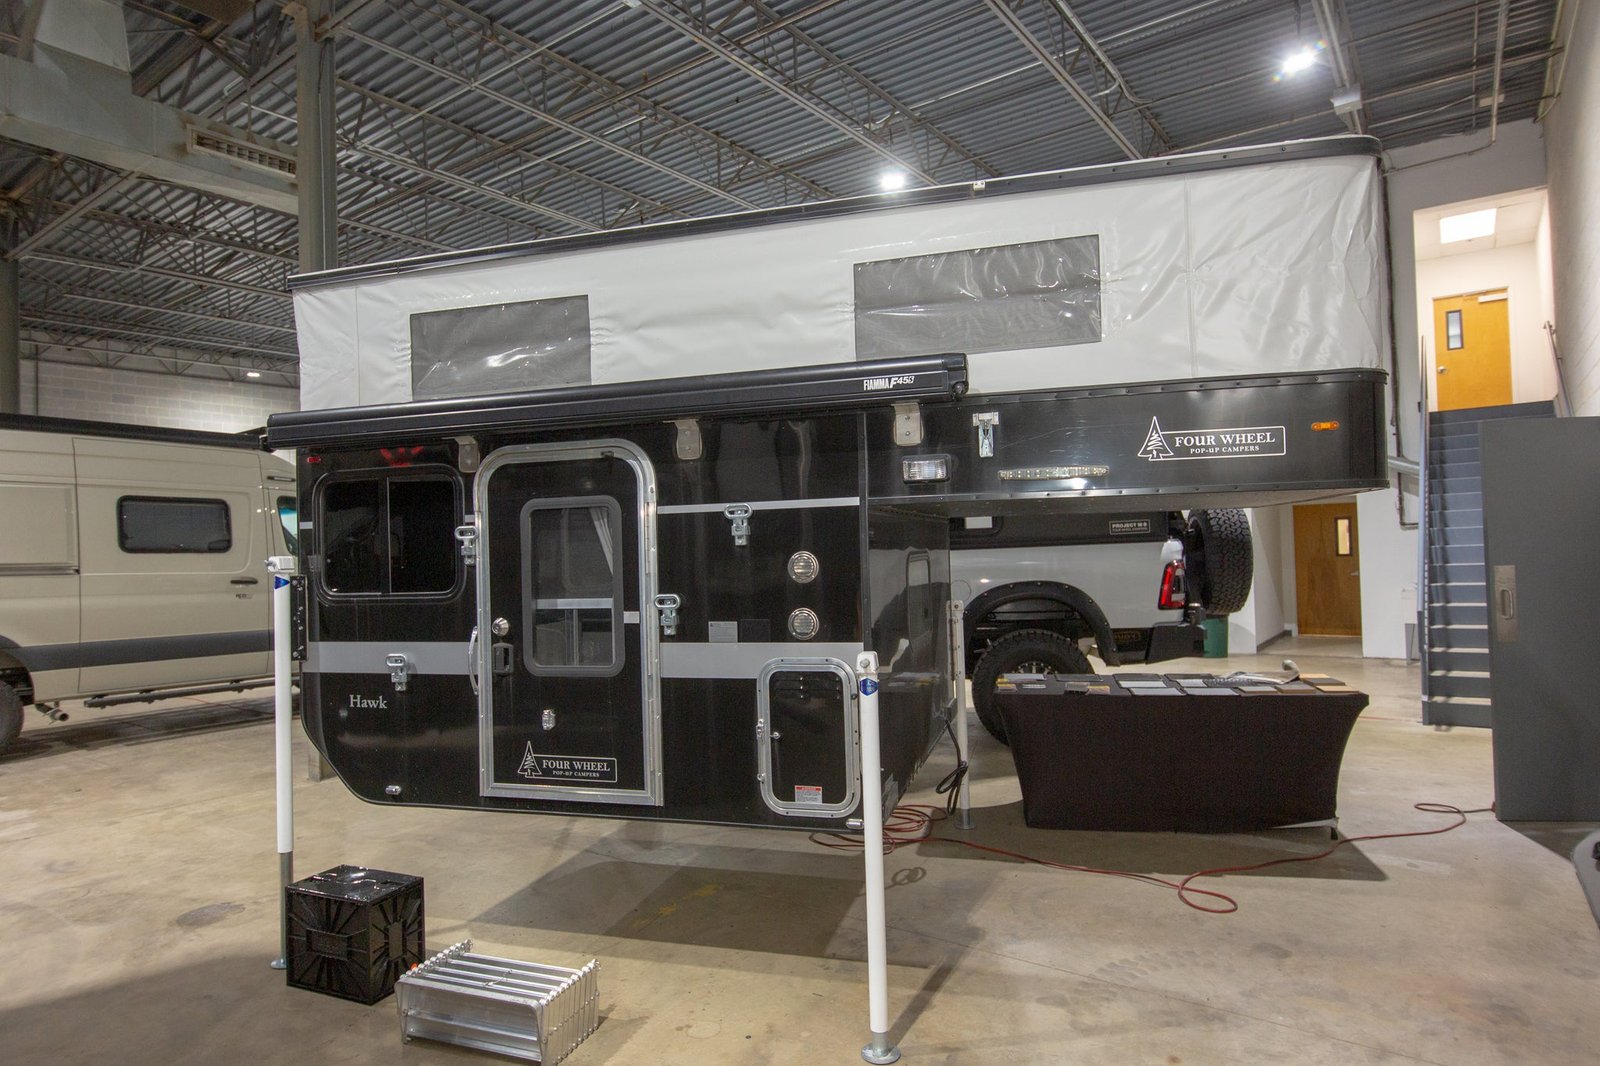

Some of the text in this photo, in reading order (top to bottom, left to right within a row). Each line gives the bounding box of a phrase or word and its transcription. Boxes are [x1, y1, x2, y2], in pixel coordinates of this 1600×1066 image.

[863, 378, 890, 391] FIAMMA
[1174, 431, 1276, 448] FOUR WHEEL
[1190, 445, 1260, 455] POP-UP CAMPERS
[349, 694, 388, 709] Hawk
[542, 759, 611, 772] FOUR WHEEL
